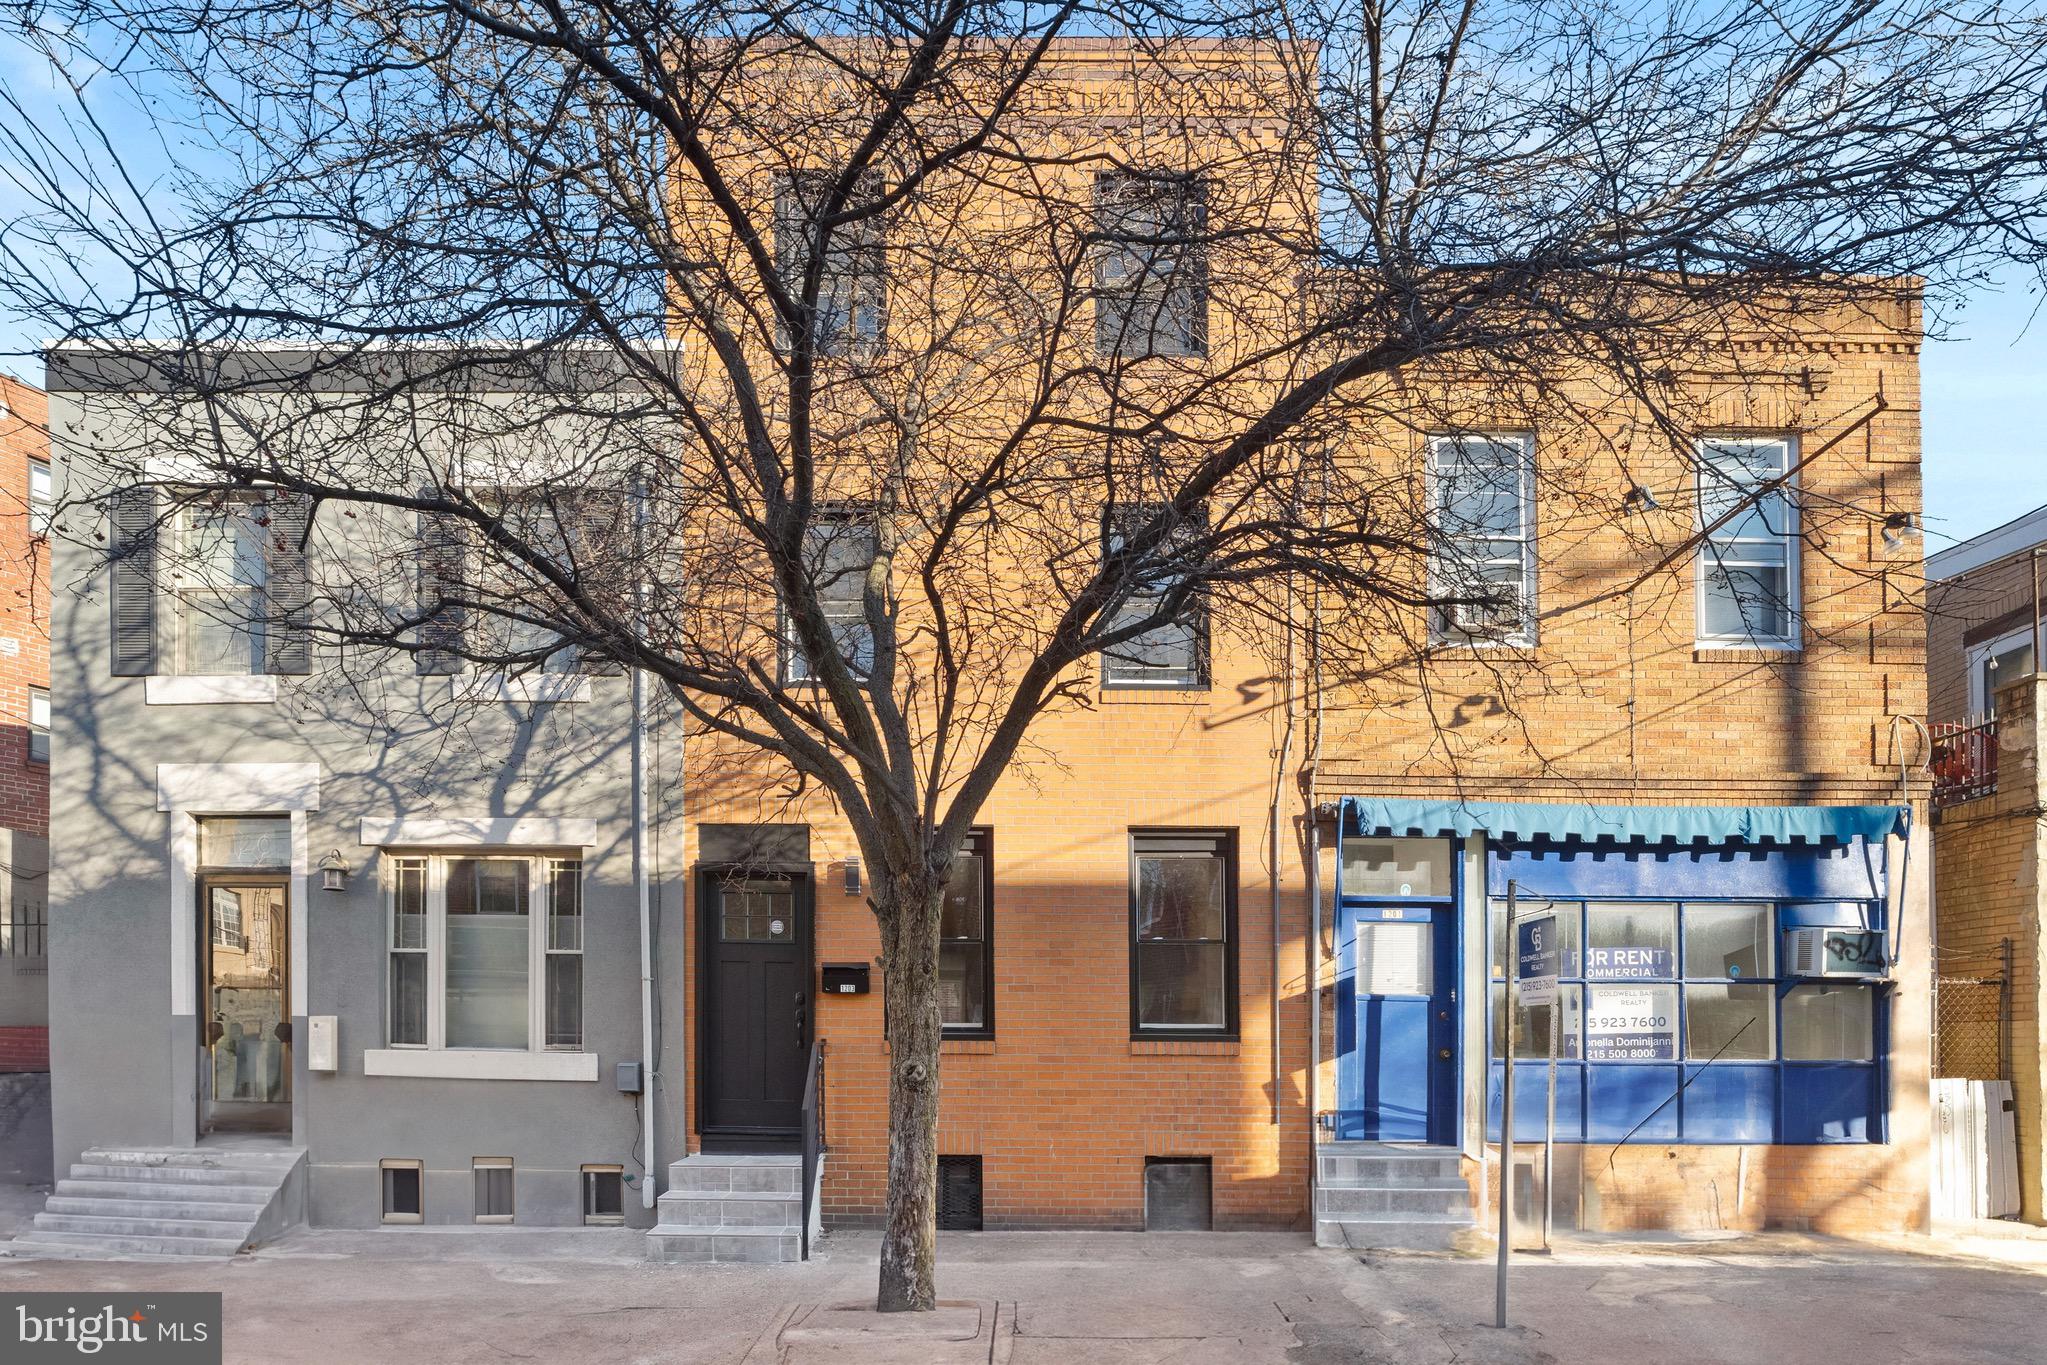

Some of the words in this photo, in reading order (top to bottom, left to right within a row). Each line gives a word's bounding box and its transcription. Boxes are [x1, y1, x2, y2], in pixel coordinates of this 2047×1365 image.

[1614, 950, 1666, 966] RENT
[1531, 963, 1545, 971] REALTY
[1587, 968, 1659, 977] OMMERCIAL
[1601, 1017, 1627, 1028] 923
[1631, 1016, 1667, 1028] 7600
[1587, 1050, 1606, 1059] 215
[1608, 1049, 1627, 1058] 500
[1630, 1048, 1656, 1058] 8000
